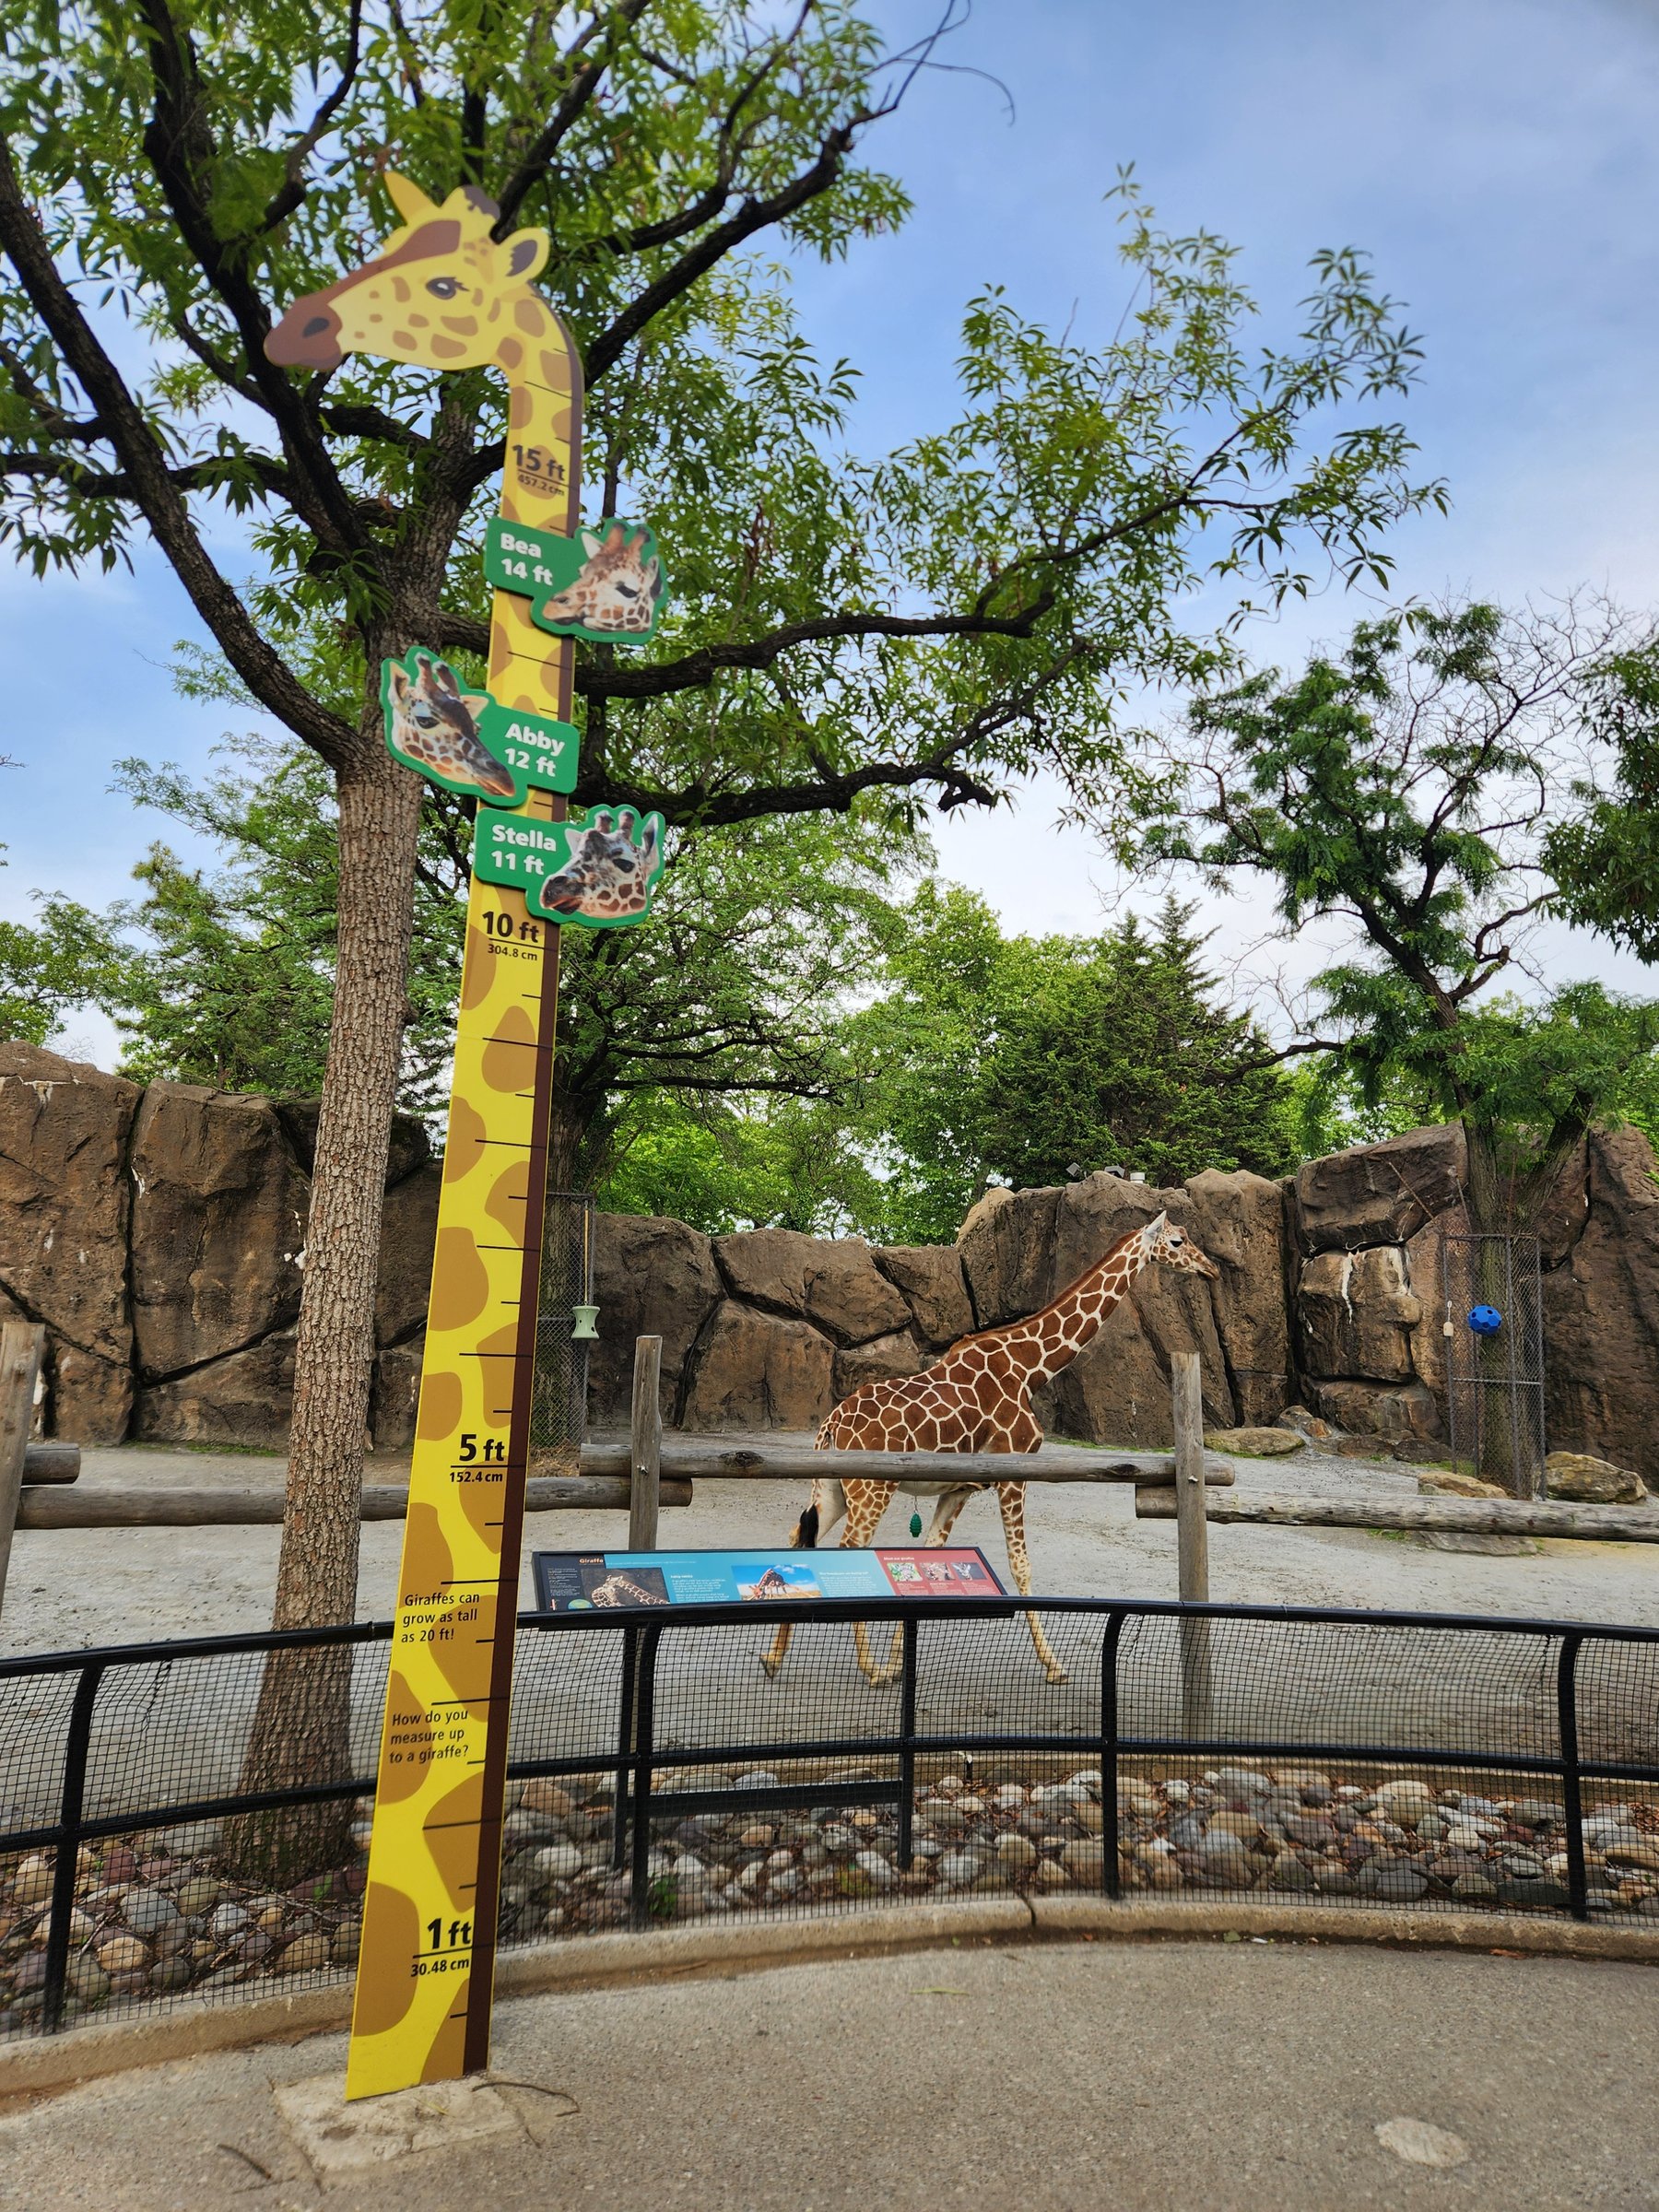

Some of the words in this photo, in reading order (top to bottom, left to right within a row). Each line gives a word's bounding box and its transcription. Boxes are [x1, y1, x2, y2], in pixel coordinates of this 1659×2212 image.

[512, 444, 542, 472] 15
[546, 460, 566, 482] ft
[518, 474, 547, 492] 457.2
[547, 485, 566, 497] cm
[500, 533, 542, 559] Bea
[500, 558, 528, 580] 14
[532, 564, 553, 586] ft
[504, 723, 566, 757] Abby
[504, 747, 530, 770] 12
[535, 755, 557, 777] ft
[491, 824, 557, 852] Stella
[490, 850, 517, 871] 11
[523, 854, 545, 876] ft
[482, 911, 513, 937] 10
[519, 922, 539, 944] ft
[487, 943, 519, 958] 304.8
[522, 949, 538, 961] cm
[459, 1434, 477, 1462] 5
[483, 1439, 505, 1462] ft
[449, 1471, 483, 1483] 152.4
[485, 1473, 503, 1482] cm
[405, 1592, 454, 1606] Giraffes
[459, 1592, 480, 1604] can
[403, 1613, 435, 1628] grow
[440, 1613, 453, 1623] as
[457, 1608, 477, 1622] tall
[401, 1631, 415, 1642] as
[419, 1629, 435, 1642] 20
[439, 1628, 454, 1641] ft!
[392, 1713, 421, 1726] How
[425, 1710, 441, 1724] do
[445, 1710, 469, 1724] you
[390, 1730, 444, 1745] measure
[449, 1728, 465, 1742] up
[389, 1750, 403, 1764] to
[406, 1752, 415, 1762] a
[418, 1744, 469, 1765] giraffe?
[427, 1917, 441, 1949] 1
[448, 1920, 472, 1947] ft
[410, 1959, 447, 1977] 30.48
[450, 1959, 469, 1971] cm
